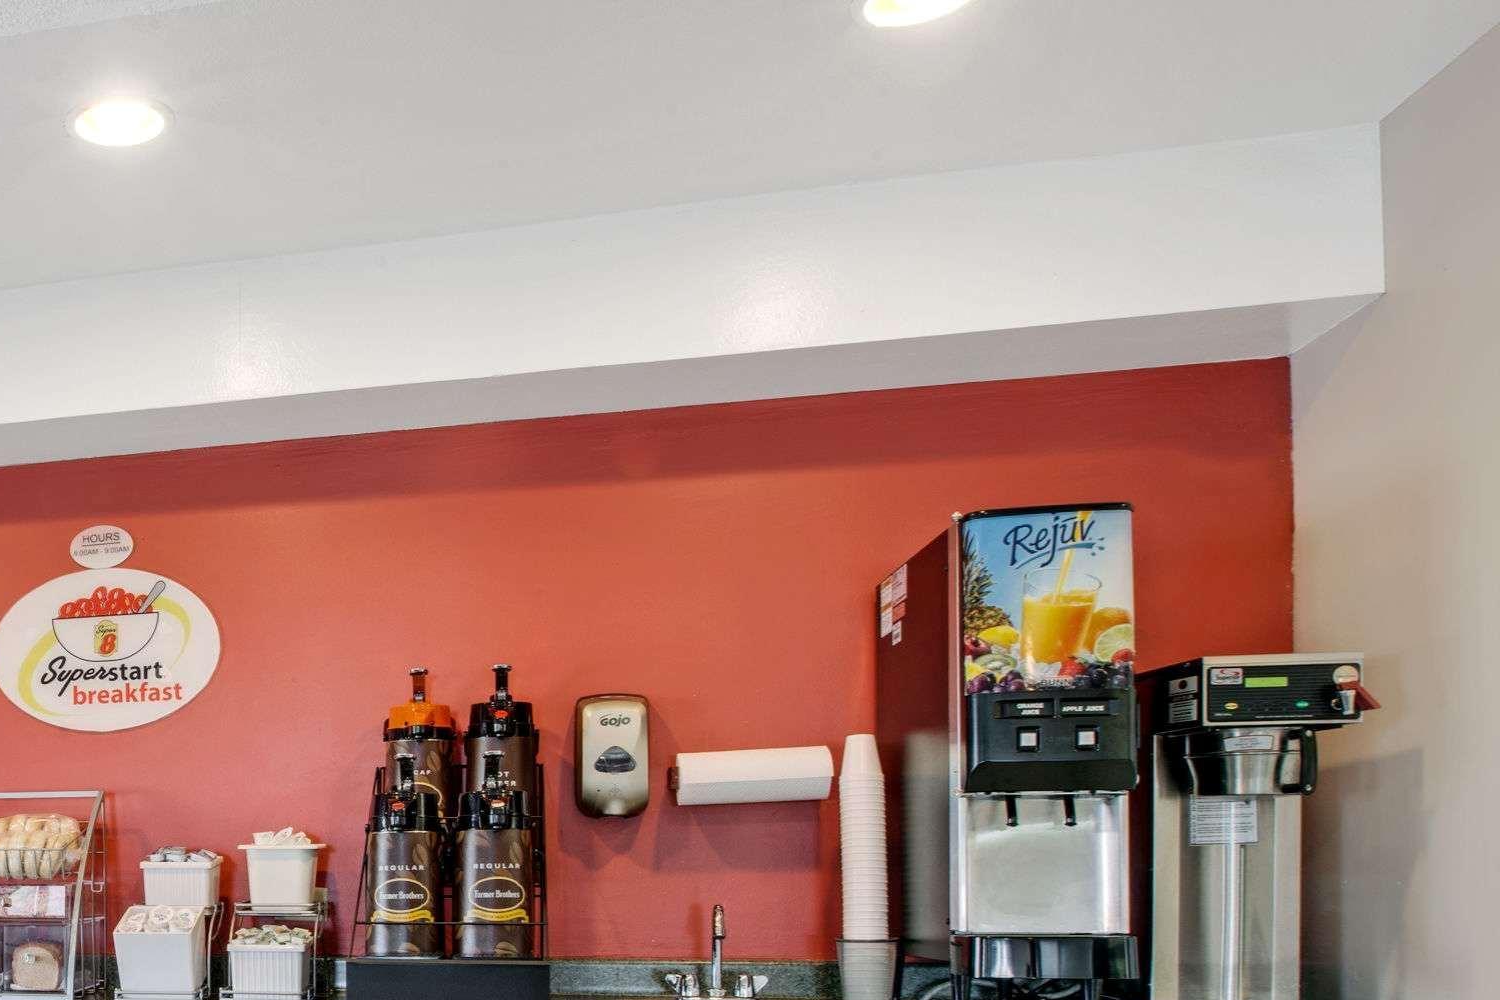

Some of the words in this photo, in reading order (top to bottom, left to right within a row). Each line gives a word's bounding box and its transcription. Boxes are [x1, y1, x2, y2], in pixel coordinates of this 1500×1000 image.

[82, 531, 120, 544] HOURS
[40, 656, 163, 697] Superstart
[73, 682, 183, 706] breakfast
[379, 864, 425, 872] REGULAR
